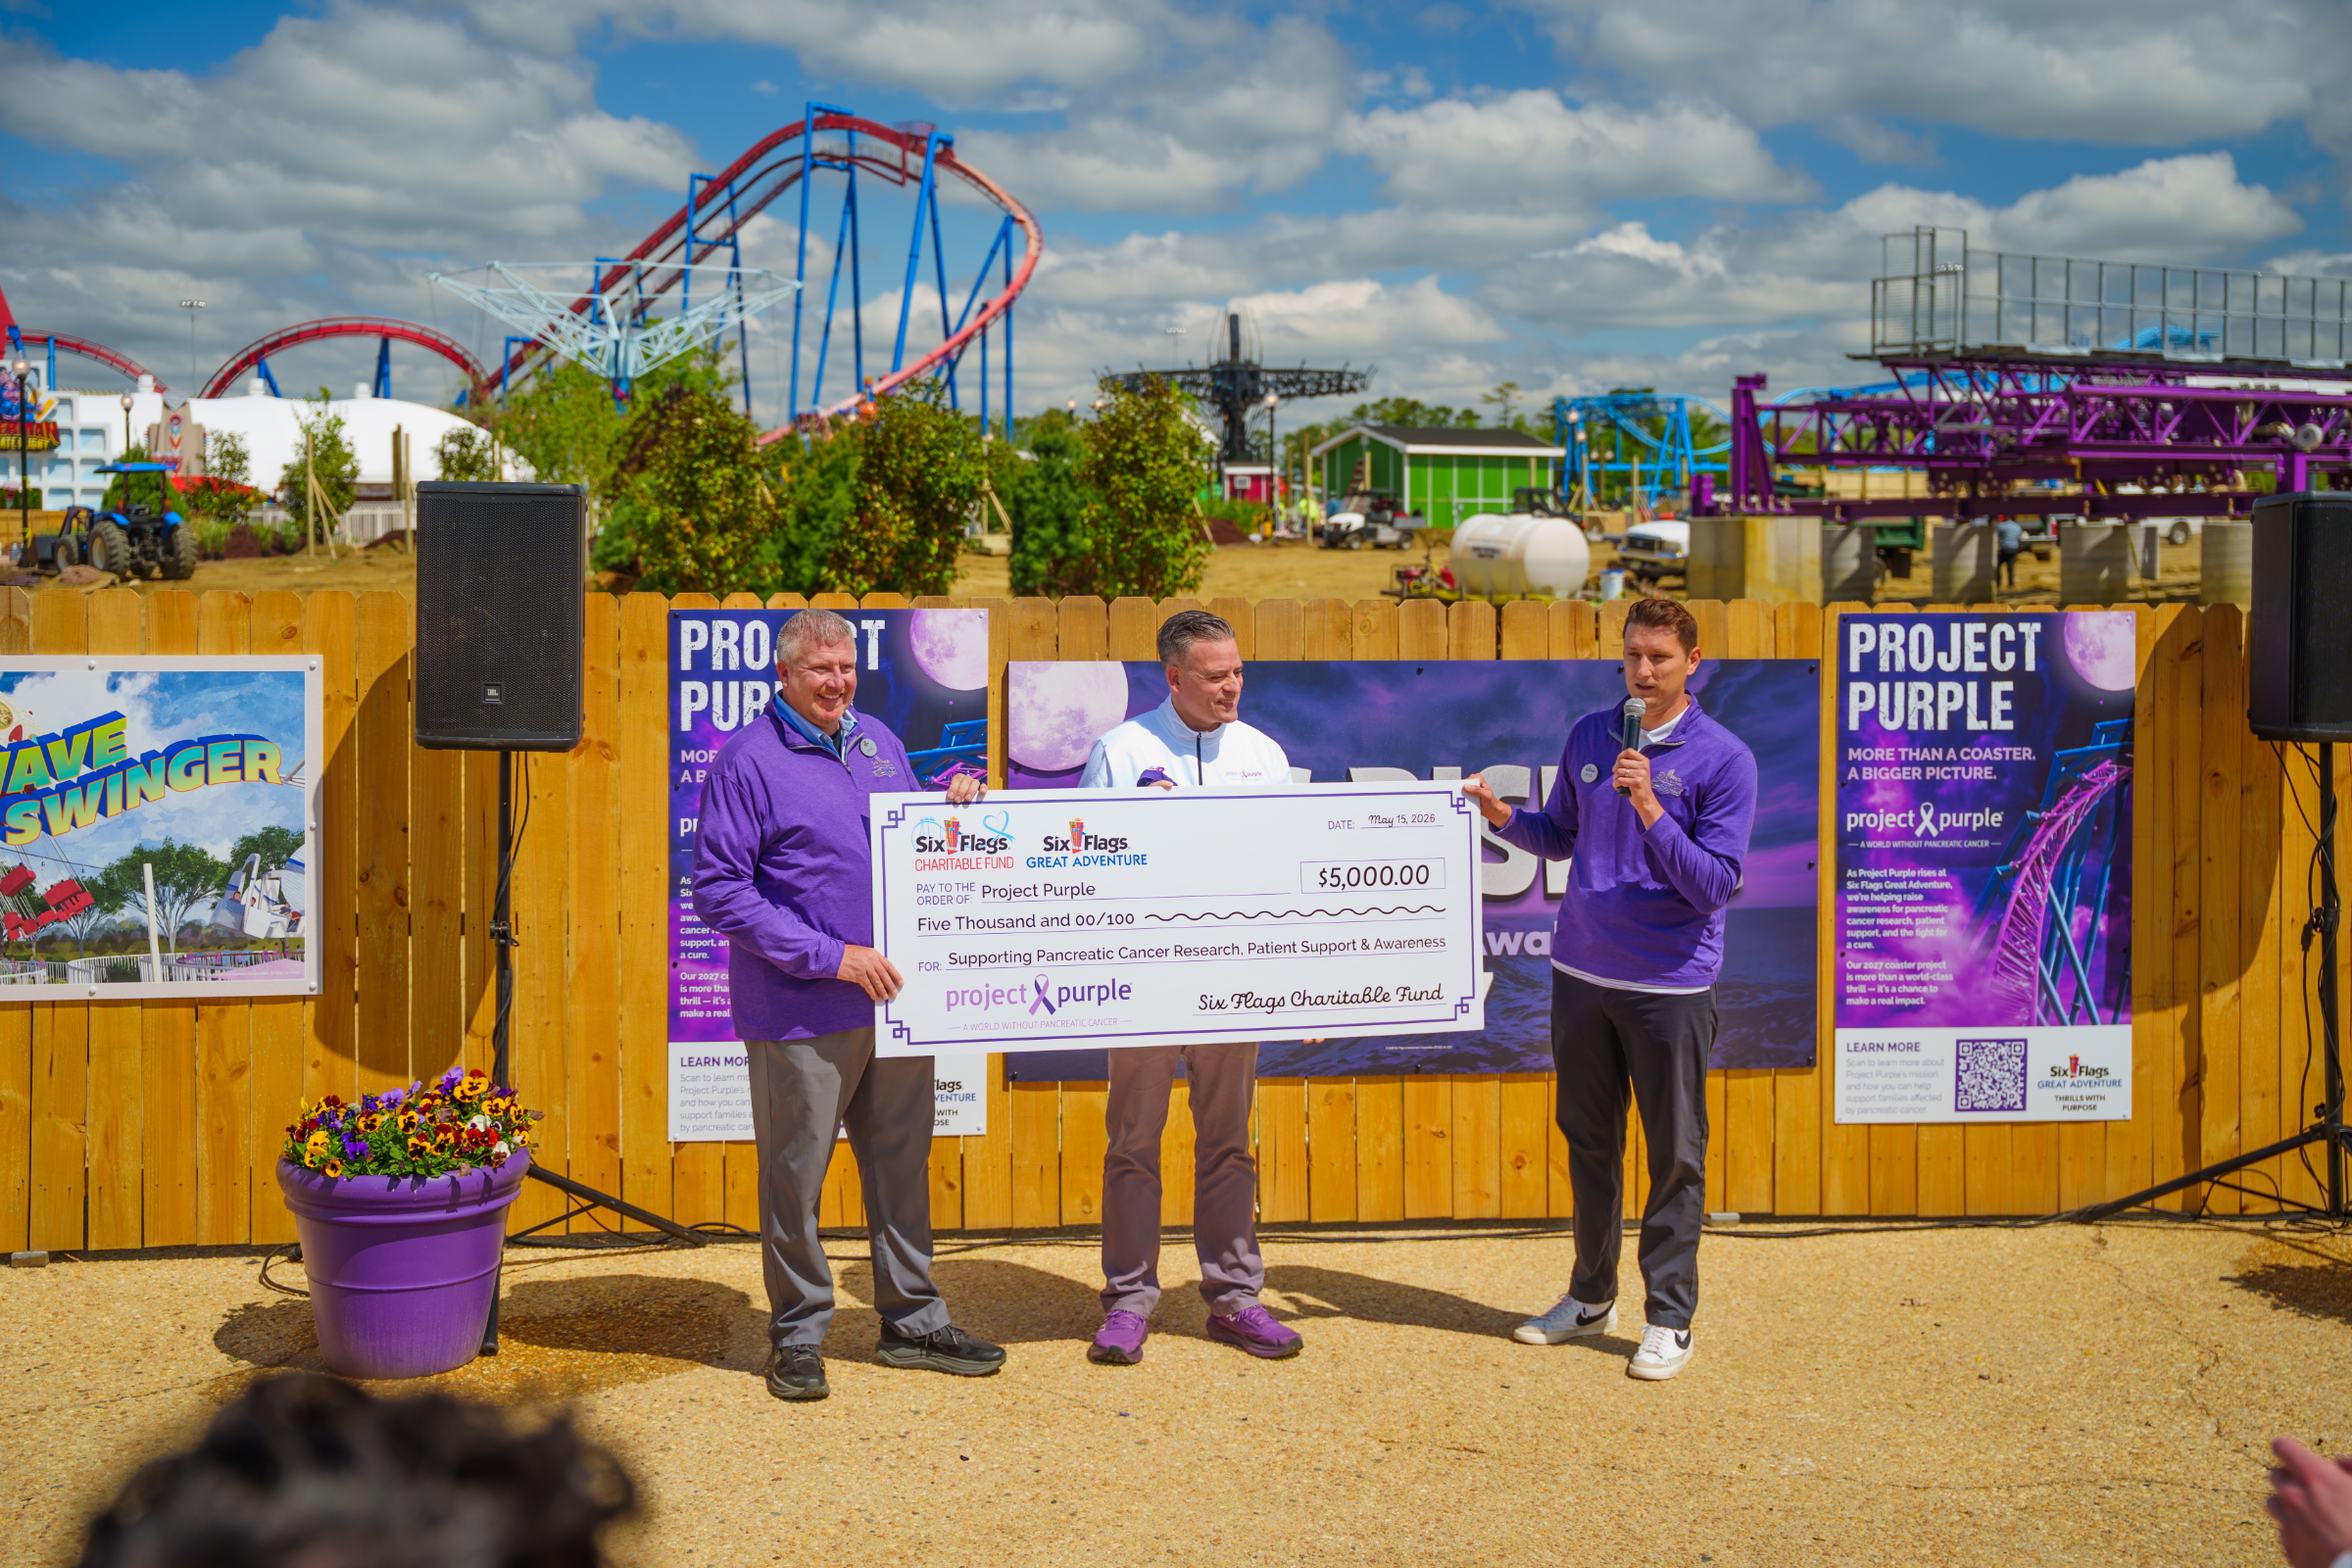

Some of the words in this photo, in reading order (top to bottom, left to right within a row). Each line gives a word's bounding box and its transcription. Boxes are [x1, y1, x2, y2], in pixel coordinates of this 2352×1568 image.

[1849, 622, 2041, 672] PROJECT
[681, 681, 783, 731] PUR
[1849, 681, 2014, 730] PURPLE
[0, 712, 126, 794] AVE
[681, 750, 718, 762] MOR
[1848, 748, 1895, 761] MORE
[1898, 748, 1942, 760] THAN
[1946, 748, 1957, 760] A
[1960, 748, 2035, 761] COASTER.
[681, 770, 692, 782] A
[1847, 767, 1859, 779] A
[1862, 767, 1922, 779] BIGGER
[1926, 766, 1996, 779] PICTURE.
[2, 735, 283, 846] SWINGER
[1328, 820, 1354, 829] DATE:
[1368, 815, 1394, 827] May
[1396, 814, 1408, 824] 15,
[1411, 814, 1435, 823] 2026
[1846, 808, 1914, 832] project
[1939, 808, 2002, 831] purple
[915, 836, 945, 853] Six
[960, 834, 1008, 855] Flags
[1044, 836, 1070, 852] Six
[1084, 834, 1128, 854] Flags
[915, 857, 982, 871] CHARITABLE
[985, 857, 1014, 869] FUND
[1026, 857, 1068, 868] GREAT
[1073, 854, 1148, 867] ADVENTURE
[1319, 864, 1429, 890] $5,000.00
[1858, 868, 1887, 879] Project
[1888, 868, 1916, 879] Purple
[1918, 868, 1936, 877] rises
[1937, 868, 1946, 877] at
[917, 884, 936, 893] PAY
[939, 883, 952, 893] TO
[955, 882, 976, 892] THE
[982, 884, 1039, 901] Project
[1044, 882, 1096, 900] Purple
[1861, 881, 1883, 891] Flags
[1908, 880, 1952, 890] Adventure,
[917, 896, 953, 906] ORDER
[956, 895, 972, 905] OF:
[1846, 893, 1869, 902] we're
[1871, 893, 1902, 903] helping
[1903, 892, 1924, 901] raise
[1905, 904, 1948, 914] pancreatic
[918, 917, 951, 931] Five
[955, 914, 1036, 930] Thousand
[1041, 913, 1070, 927] and
[1075, 912, 1134, 926] 00/100
[1916, 916, 1944, 926] patient
[1846, 929, 1881, 939] support,
[1883, 928, 1898, 937] and
[1900, 928, 1914, 937] the
[1916, 928, 1935, 939] fight
[1936, 928, 1947, 937] for
[680, 939, 716, 949] support,
[949, 951, 1032, 967] Supporting
[1038, 948, 1114, 961] Pancreatic
[1118, 946, 1169, 958] Cancer
[1174, 943, 1244, 957] Research,
[1248, 942, 1297, 955] Patient
[1300, 938, 1356, 954] Support
[1360, 939, 1370, 951] &
[1374, 937, 1446, 950] Awareness
[918, 962, 942, 971] FOR:
[1846, 960, 1862, 969] Our
[1863, 961, 1884, 970] 2027
[1885, 960, 1916, 969] coaster
[1917, 960, 1946, 971] project
[1846, 972, 1853, 981] is
[1905, 972, 1953, 981] world-class
[947, 983, 1027, 1011] project
[1057, 978, 1132, 1007] purple
[1199, 994, 1228, 1010] Six
[1231, 992, 1286, 1014] Flags
[1290, 986, 1391, 1006] Charitable
[1396, 983, 1444, 1003] Fund
[1846, 997, 1869, 1005] make
[1895, 997, 1926, 1006] impact.
[713, 1008, 730, 1017] real
[970, 1022, 1000, 1031] WORLD
[1002, 1021, 1038, 1030] WITHOUT
[1041, 1019, 1085, 1028] PANCREATIC
[1088, 1018, 1117, 1027] CANCER
[1847, 1043, 1885, 1053] LEARN
[1887, 1042, 1921, 1052] MORE
[681, 1056, 720, 1067] LEARN
[2050, 1066, 2068, 1077] Six
[2079, 1065, 2109, 1078] Flags
[934, 1079, 961, 1093] lags
[2037, 1080, 2067, 1089] GREAT
[2070, 1079, 2122, 1088] ADVENTURE
[680, 1086, 709, 1096] Project
[712, 1086, 745, 1095] Purple's
[718, 1100, 732, 1108] you
[680, 1111, 711, 1120] support
[680, 1123, 690, 1133] by
[693, 1123, 736, 1133] pancreatic
